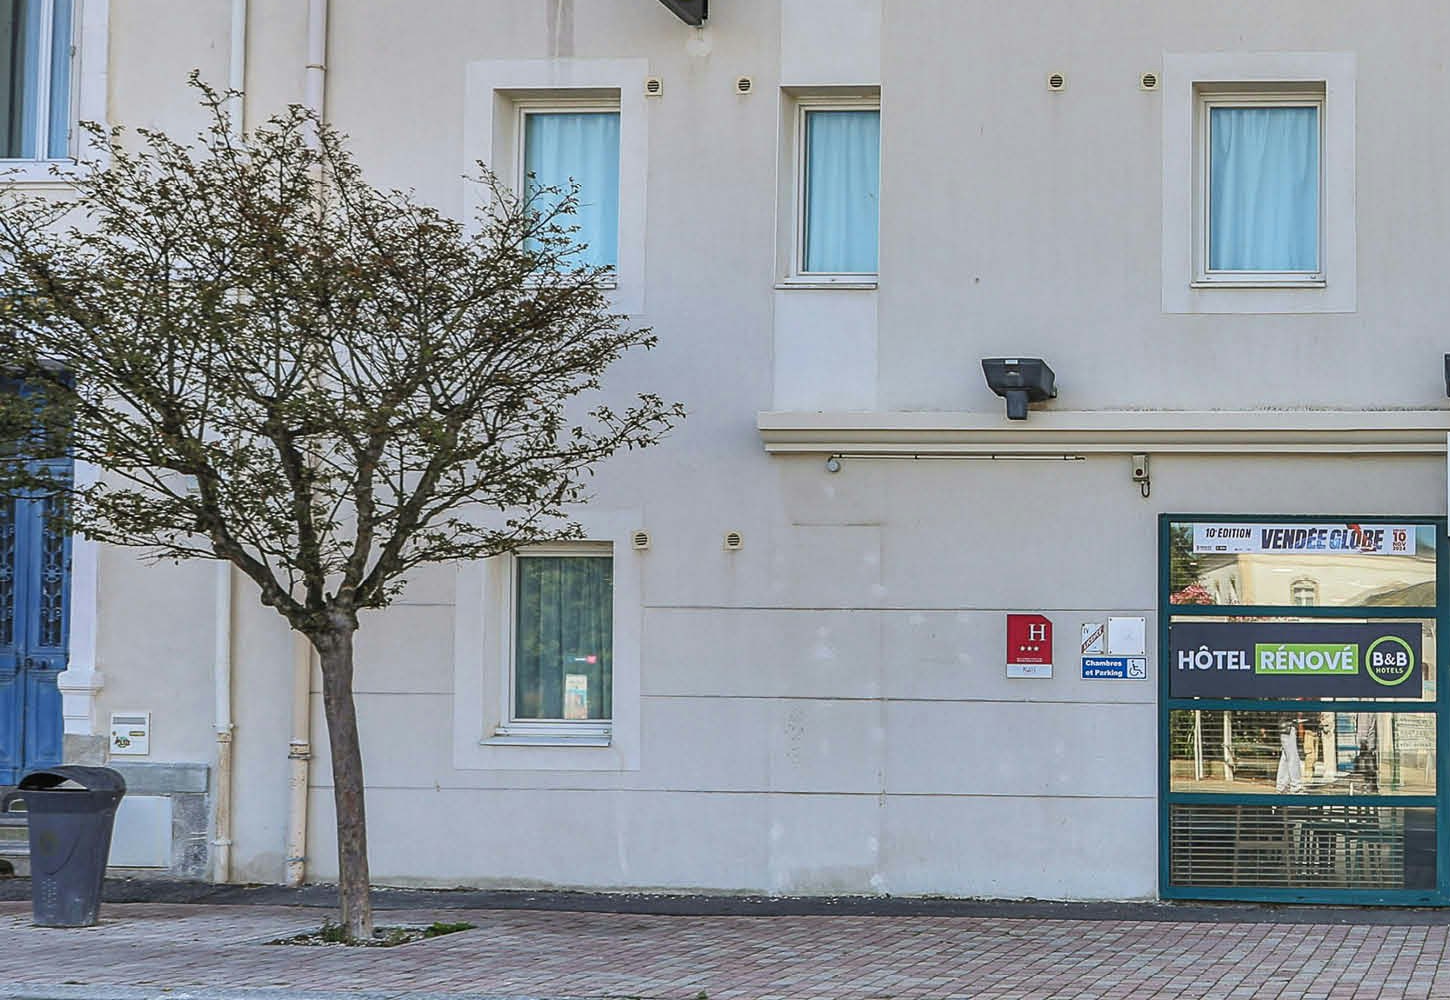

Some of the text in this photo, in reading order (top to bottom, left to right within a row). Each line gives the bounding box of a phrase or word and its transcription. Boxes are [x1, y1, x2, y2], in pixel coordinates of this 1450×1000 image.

[1261, 527, 1385, 550] VENDÉE GLOBE
[1393, 532, 1406, 541] 10
[1029, 623, 1047, 641] H
[1085, 659, 1122, 667] Chambres
[1177, 645, 1354, 670] HÔTEL RÉNOVÉ
[1373, 651, 1408, 666] B&B
[1094, 669, 1123, 678] Parking
